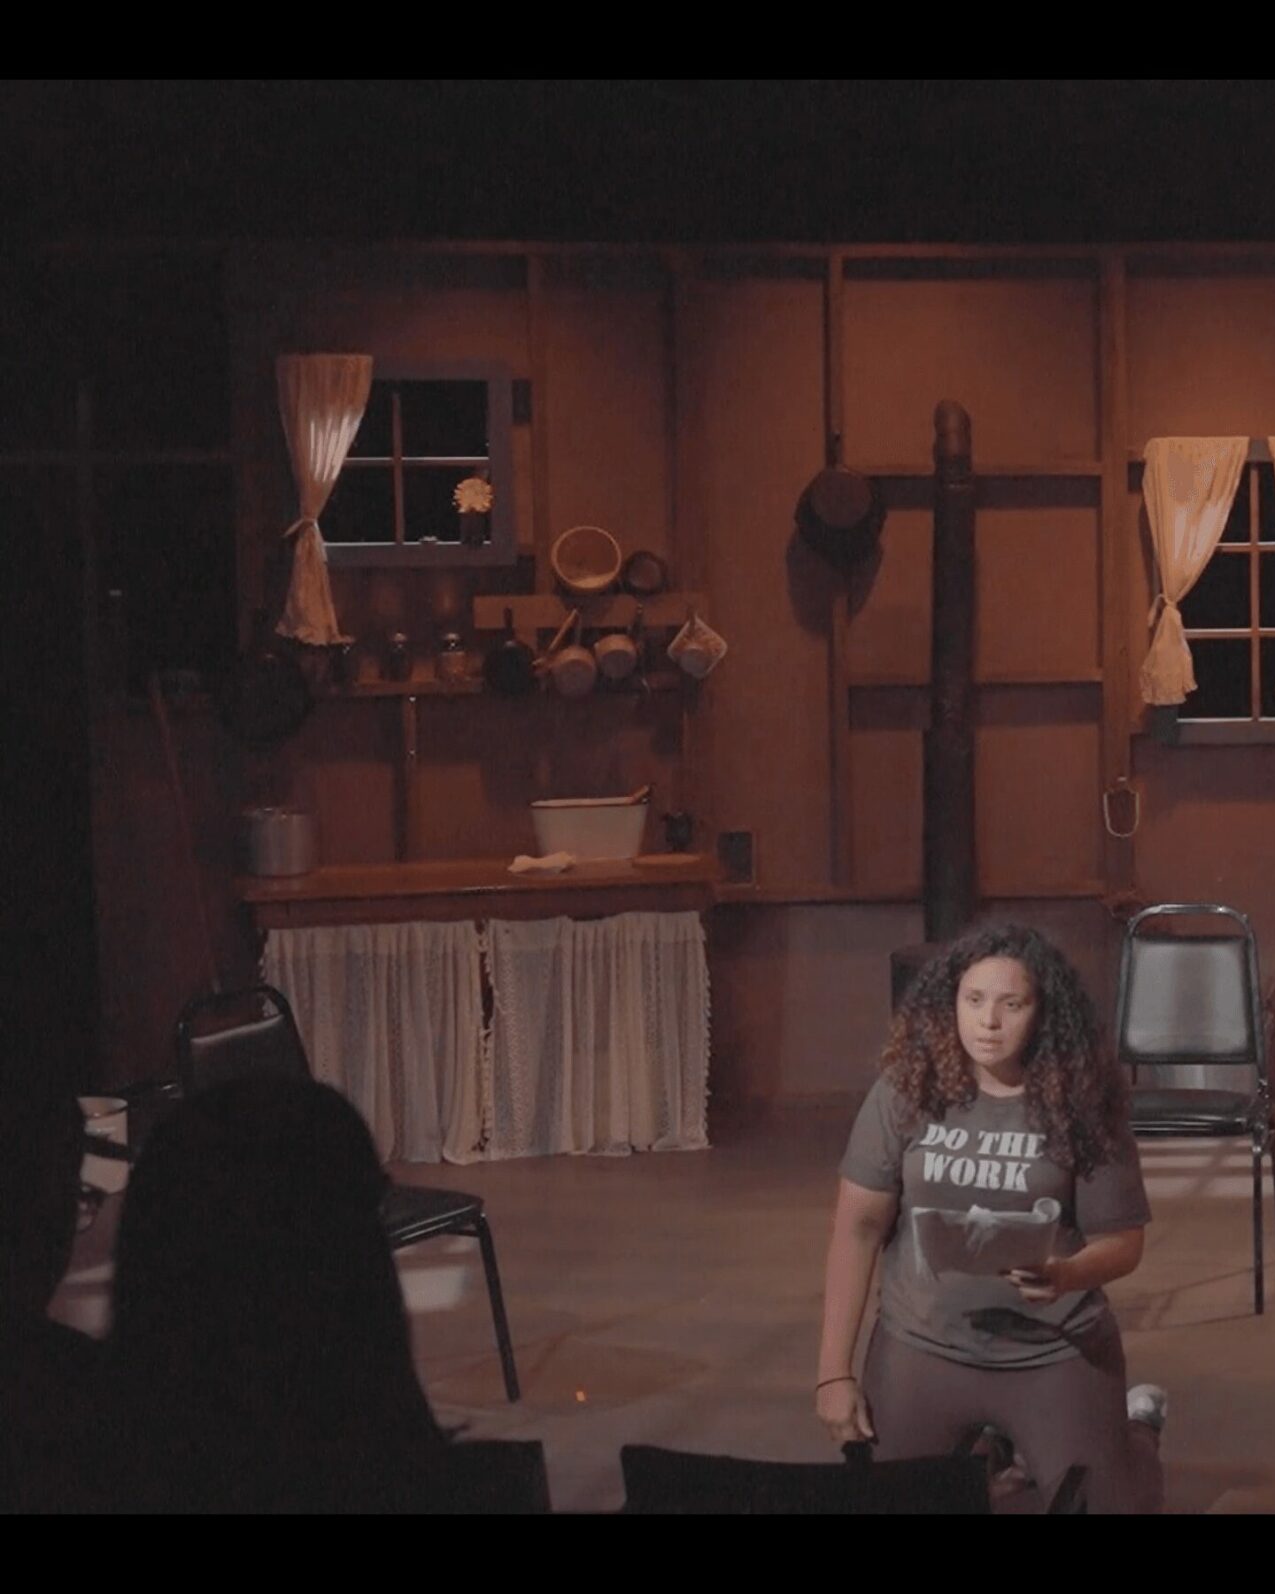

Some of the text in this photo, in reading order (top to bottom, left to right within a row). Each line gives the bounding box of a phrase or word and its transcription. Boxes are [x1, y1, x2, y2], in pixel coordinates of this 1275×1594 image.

[919, 1123, 1047, 1159] DO THE
[922, 1151, 1031, 1192] WORK
